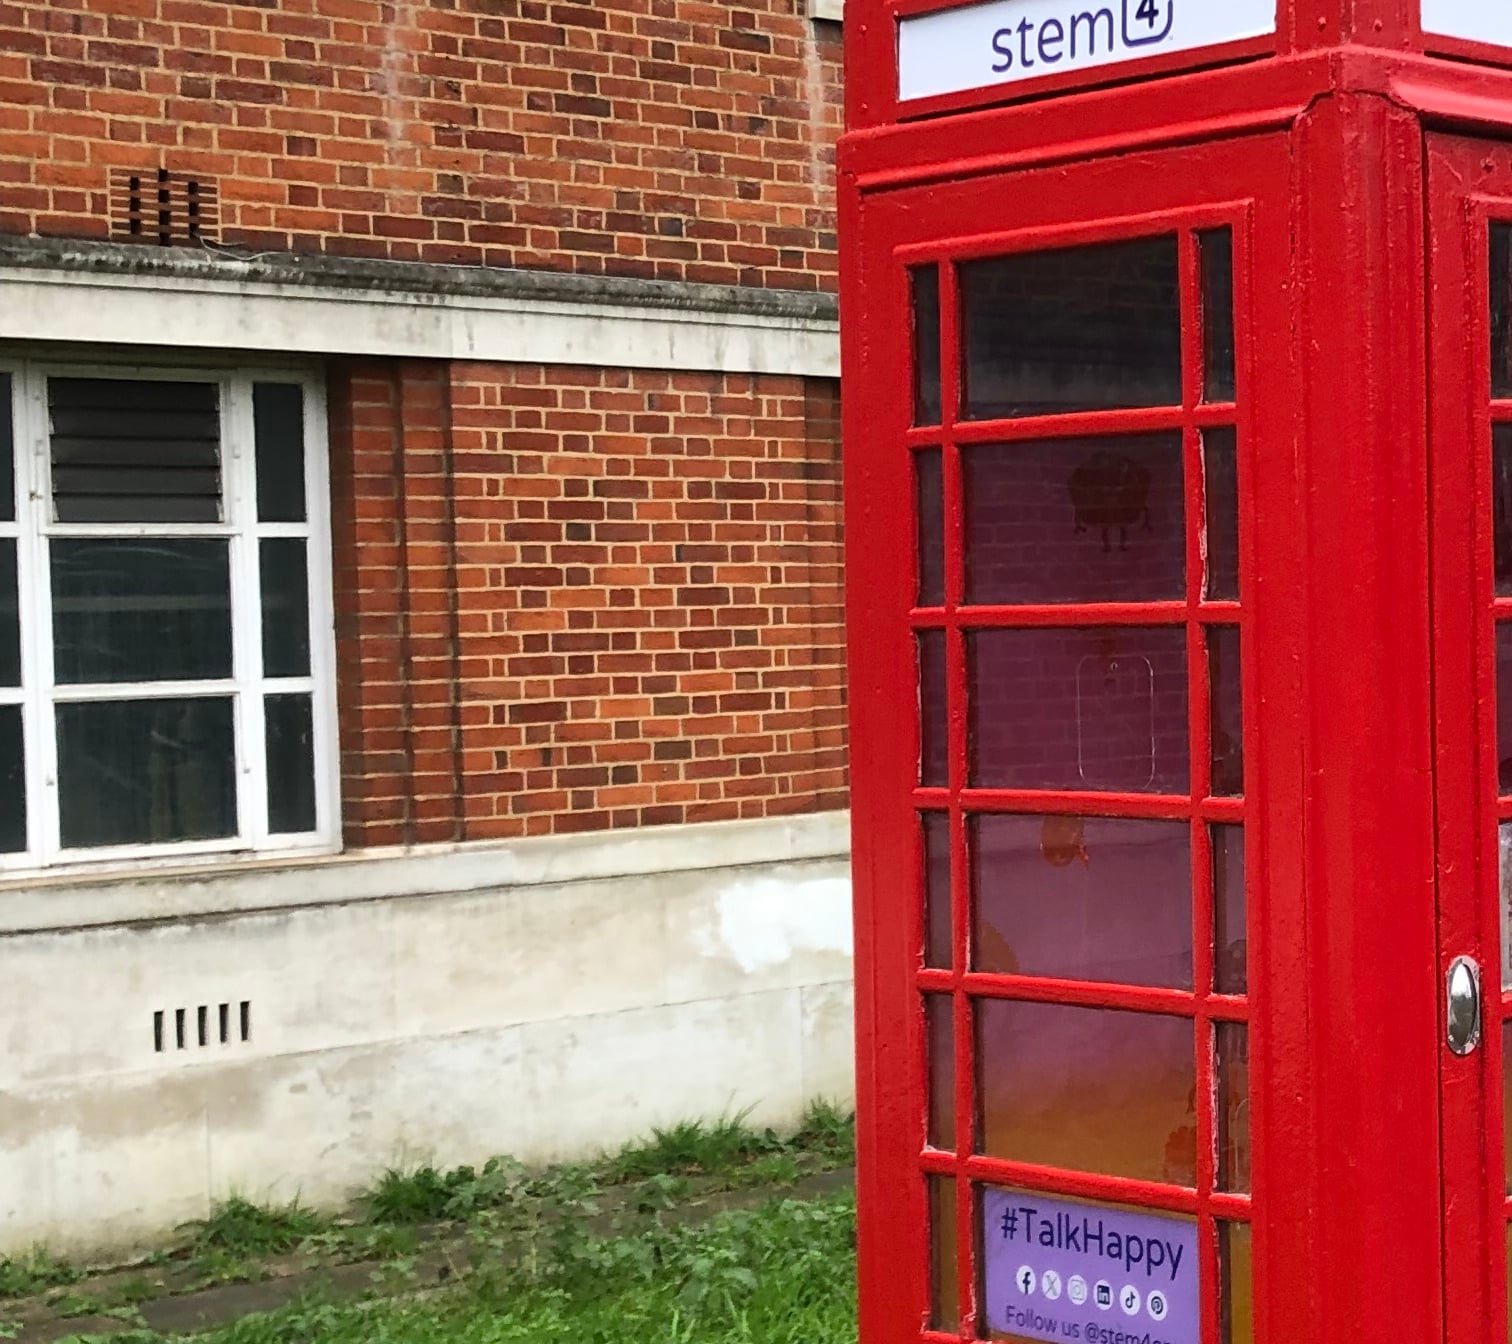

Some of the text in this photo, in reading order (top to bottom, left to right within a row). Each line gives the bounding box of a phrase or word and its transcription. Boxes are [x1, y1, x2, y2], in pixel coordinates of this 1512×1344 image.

[1001, 1207, 1184, 1281] #TalkHappy
[1006, 1305, 1058, 1334] Follow
[1061, 1319, 1080, 1339] us
